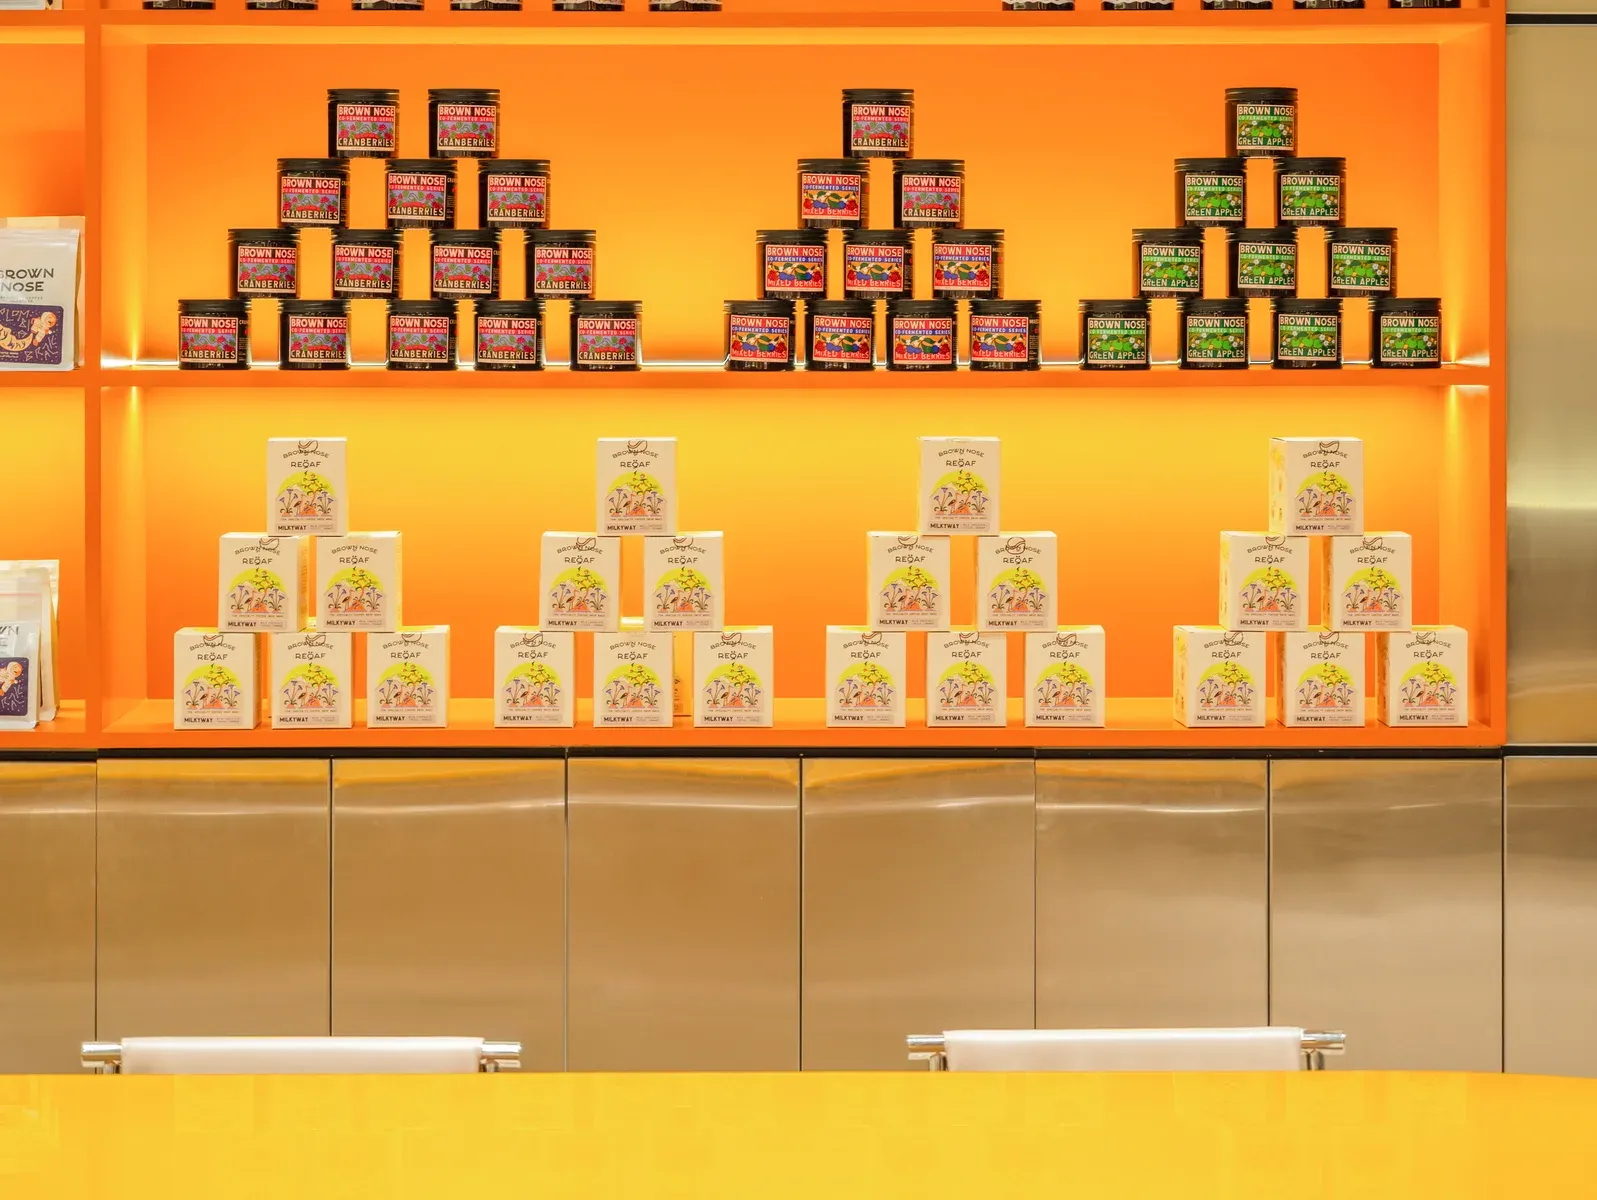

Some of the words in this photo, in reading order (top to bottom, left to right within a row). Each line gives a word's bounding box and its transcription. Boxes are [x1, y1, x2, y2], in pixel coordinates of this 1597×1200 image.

[339, 107, 370, 116] BROWN
[374, 108, 395, 117] NOSE
[440, 107, 471, 116] BROWN
[475, 108, 495, 117] NOSE
[854, 107, 885, 116] BROWN
[889, 108, 909, 117] NOSE
[1239, 107, 1271, 115] BROWN
[1274, 107, 1294, 116] NOSE
[339, 138, 394, 147] CRANBERRIES
[439, 138, 495, 147] CRANBERRIES
[853, 138, 909, 147] CRANBERRIES
[1267, 138, 1294, 146] APPLES
[904, 178, 936, 186] BROWN
[939, 178, 960, 187] NOSE
[1187, 178, 1218, 186] BROWN
[1221, 178, 1242, 186] NOSE
[904, 208, 960, 217] CRANBERRIES
[1187, 208, 1212, 216] GREEN
[1214, 208, 1242, 217] APPLES
[768, 248, 799, 256] BROWN
[803, 248, 823, 257] NOSE
[1241, 245, 1273, 254] BROWN
[1276, 246, 1296, 255] NOSE
[1240, 276, 1265, 284] GREEN
[1268, 277, 1295, 285] APPLES
[292, 319, 324, 328] BROWN
[327, 319, 347, 328] NOSE
[732, 318, 762, 327] BROWN
[766, 319, 788, 328] NOSE
[816, 318, 847, 327] BROWN
[850, 320, 870, 328] NOSE
[896, 321, 926, 329] BROWN
[930, 321, 951, 329] NOSE
[1383, 319, 1415, 327] BROWN
[1418, 319, 1438, 328] NOSE
[291, 350, 347, 359] CRANBERRIES
[1411, 349, 1438, 358] APPLES
